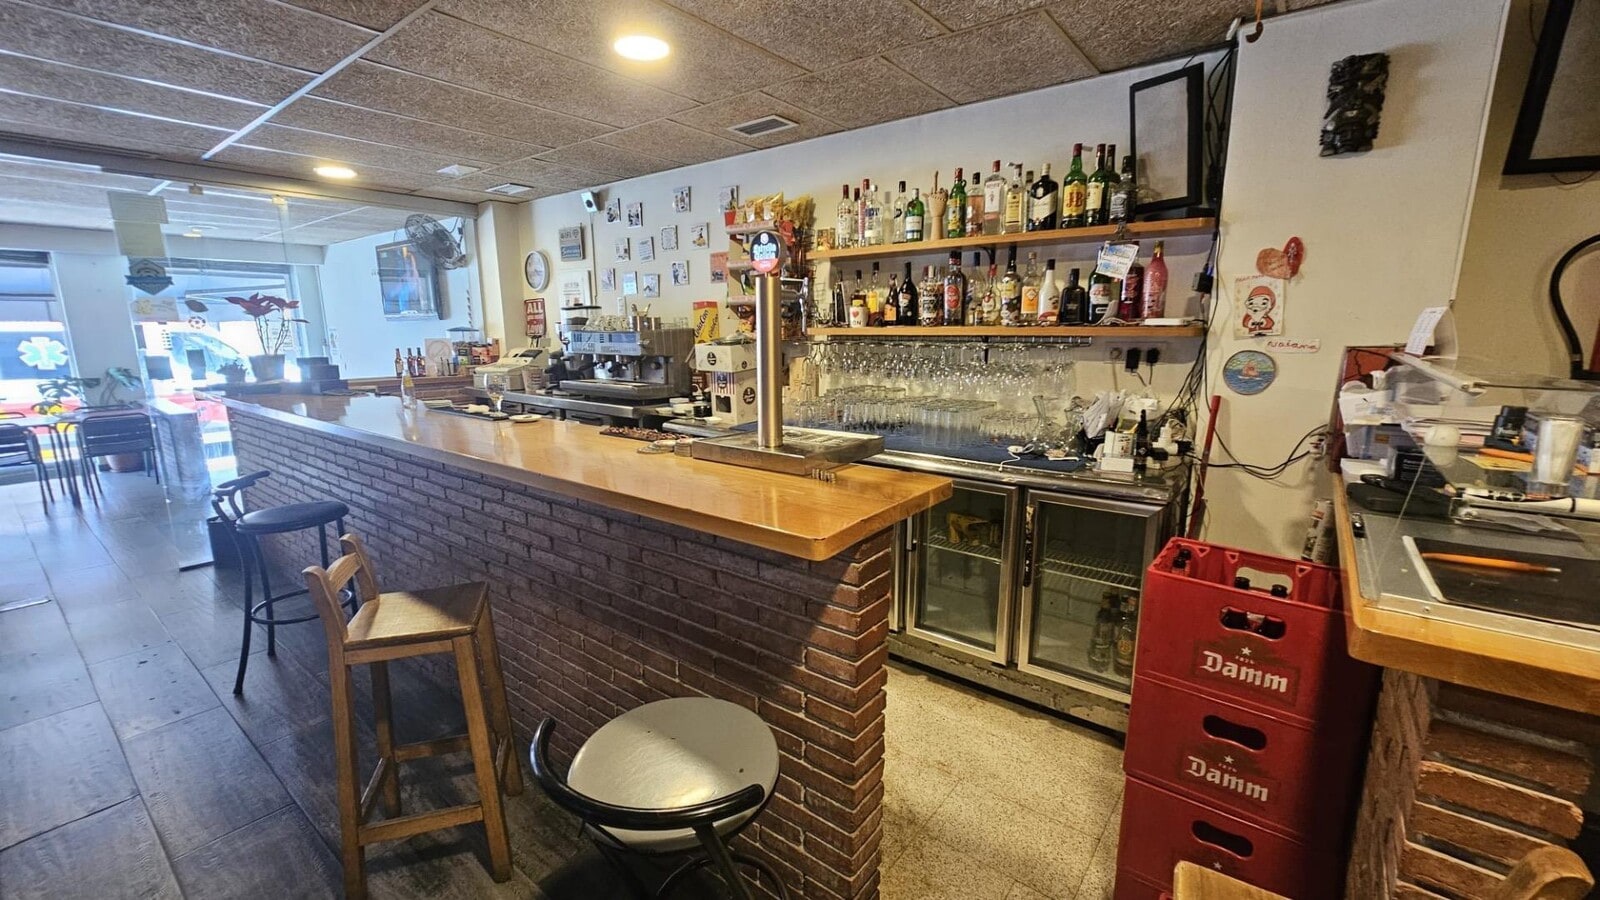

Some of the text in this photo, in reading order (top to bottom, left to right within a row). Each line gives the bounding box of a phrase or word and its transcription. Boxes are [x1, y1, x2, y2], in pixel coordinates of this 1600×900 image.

[527, 302, 544, 314] ALL
[1200, 650, 1288, 693] Damm
[1185, 755, 1269, 802] Damm
